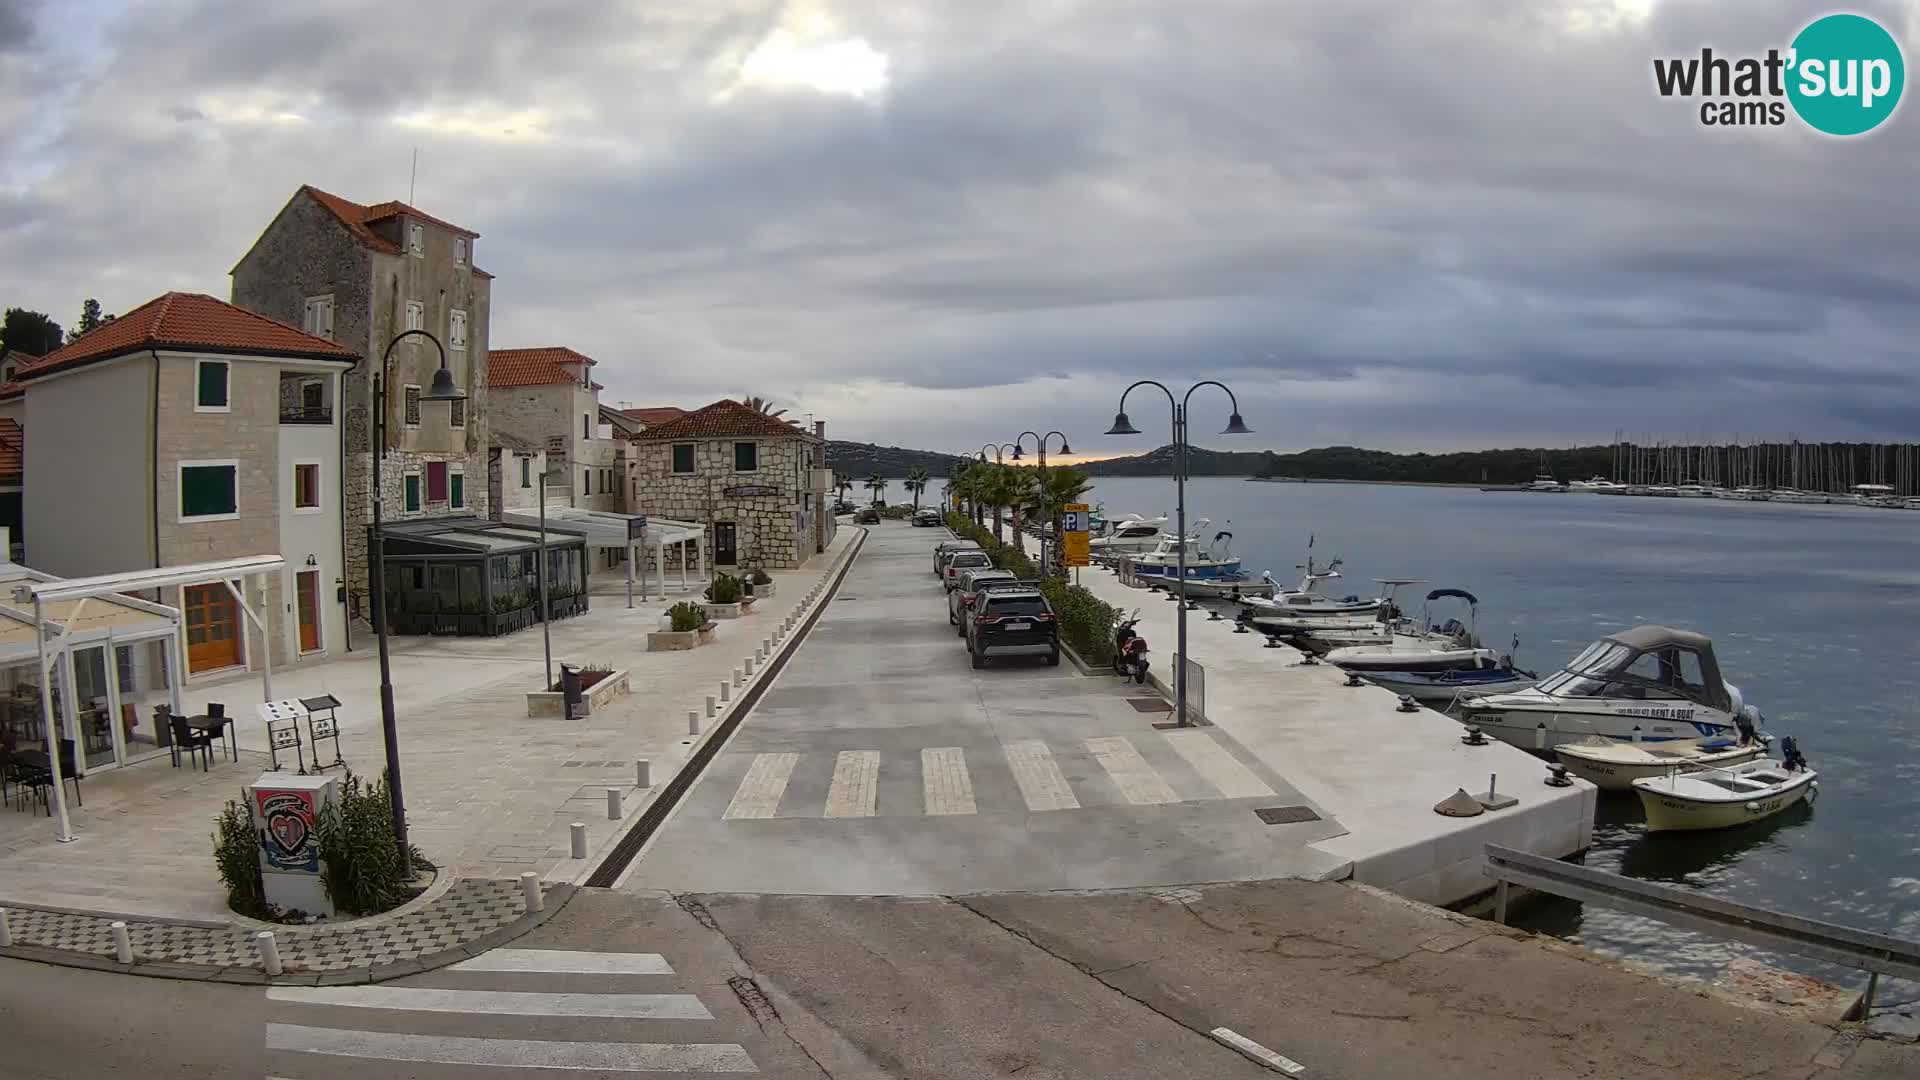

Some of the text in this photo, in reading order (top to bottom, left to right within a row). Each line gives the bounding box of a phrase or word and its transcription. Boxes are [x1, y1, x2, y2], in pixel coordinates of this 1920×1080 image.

[1066, 513, 1076, 530] P
[1650, 708, 1669, 718] RENT
[1677, 709, 1696, 721] BOAT
